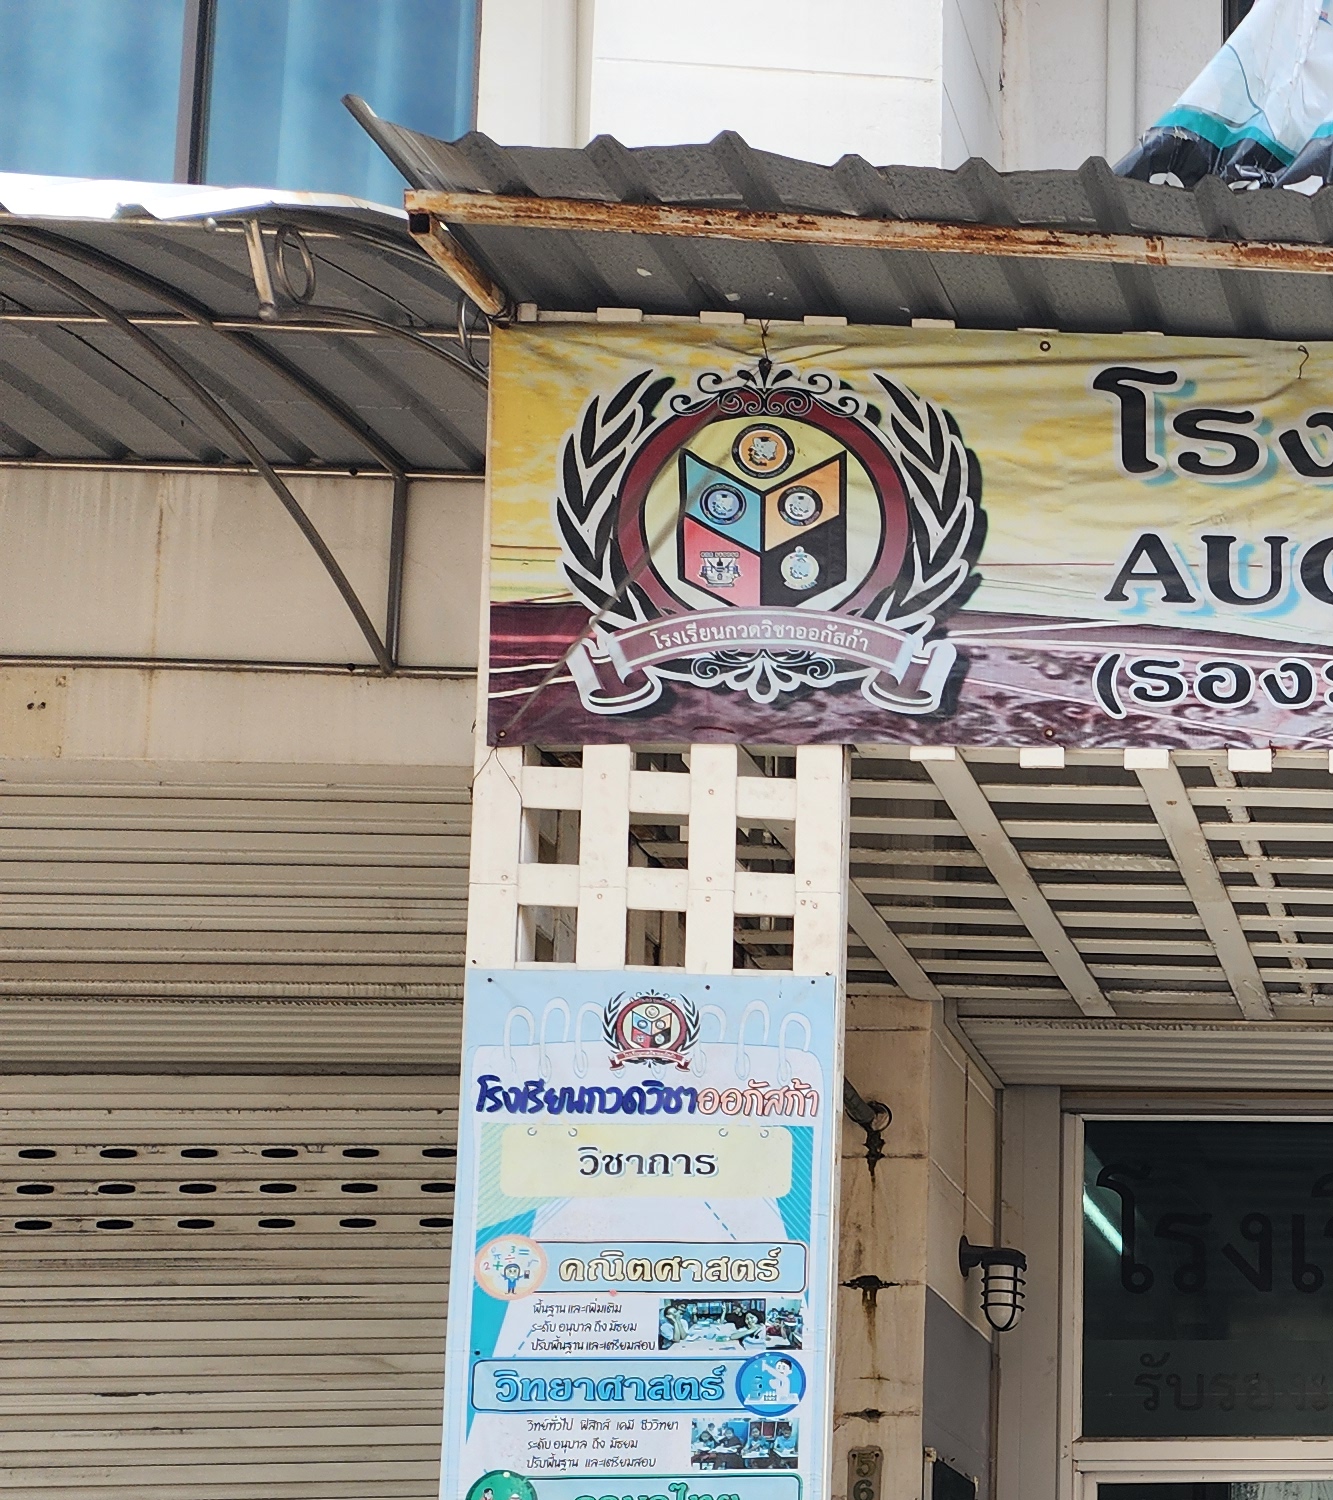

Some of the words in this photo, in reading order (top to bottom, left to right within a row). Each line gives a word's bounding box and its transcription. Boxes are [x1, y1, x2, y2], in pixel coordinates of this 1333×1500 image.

[651, 620, 868, 652] โรงเรียนกวดวิชาออกัสก้า
[475, 1074, 820, 1117] โรงเรียนกวดวิชาออกัสก้า
[578, 1146, 718, 1177] วิชาการ
[558, 1246, 782, 1283] คณิตศาสตร์
[533, 1298, 566, 1317] พื้นฐาน
[559, 1321, 592, 1336] อนุบาล
[594, 1320, 607, 1333] ถึง
[609, 1320, 637, 1333] มัธยม
[531, 1336, 584, 1354] ปรับพื้นฐาน
[586, 1337, 656, 1351] และเตรียมสอบ
[493, 1364, 727, 1402] วิทยาศาสตร์
[580, 1418, 611, 1432] ฟิสิกส์
[616, 1419, 635, 1431] เคมี
[640, 1418, 679, 1432] ชีววิทยา
[553, 1438, 588, 1453] อนุบาล
[592, 1437, 606, 1450] ถึง
[609, 1437, 638, 1450] มัธยม
[526, 1453, 579, 1472] ปรับพื้นฐาน
[585, 1455, 656, 1469] และเตรียมสอบ
